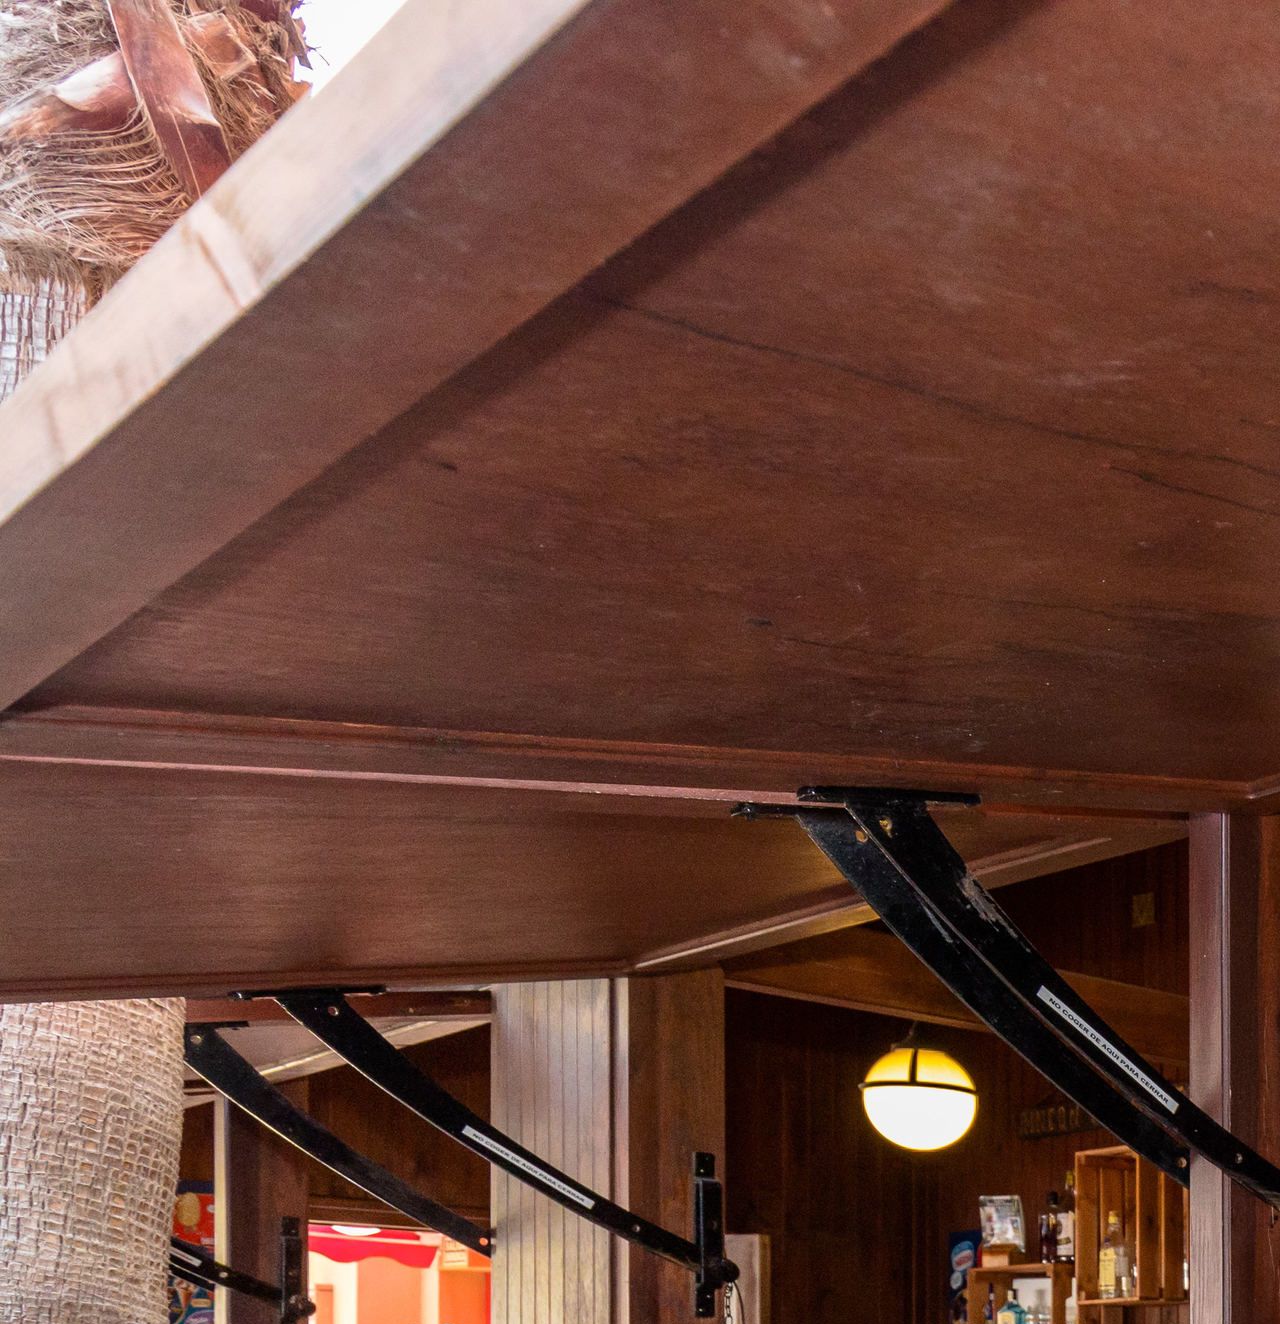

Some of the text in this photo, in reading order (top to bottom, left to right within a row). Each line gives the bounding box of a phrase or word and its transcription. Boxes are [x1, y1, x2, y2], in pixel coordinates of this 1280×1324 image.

[1048, 997, 1169, 1104] NO COGER DE AQUI PARA CERRAR
[472, 1133, 483, 1141] NO
